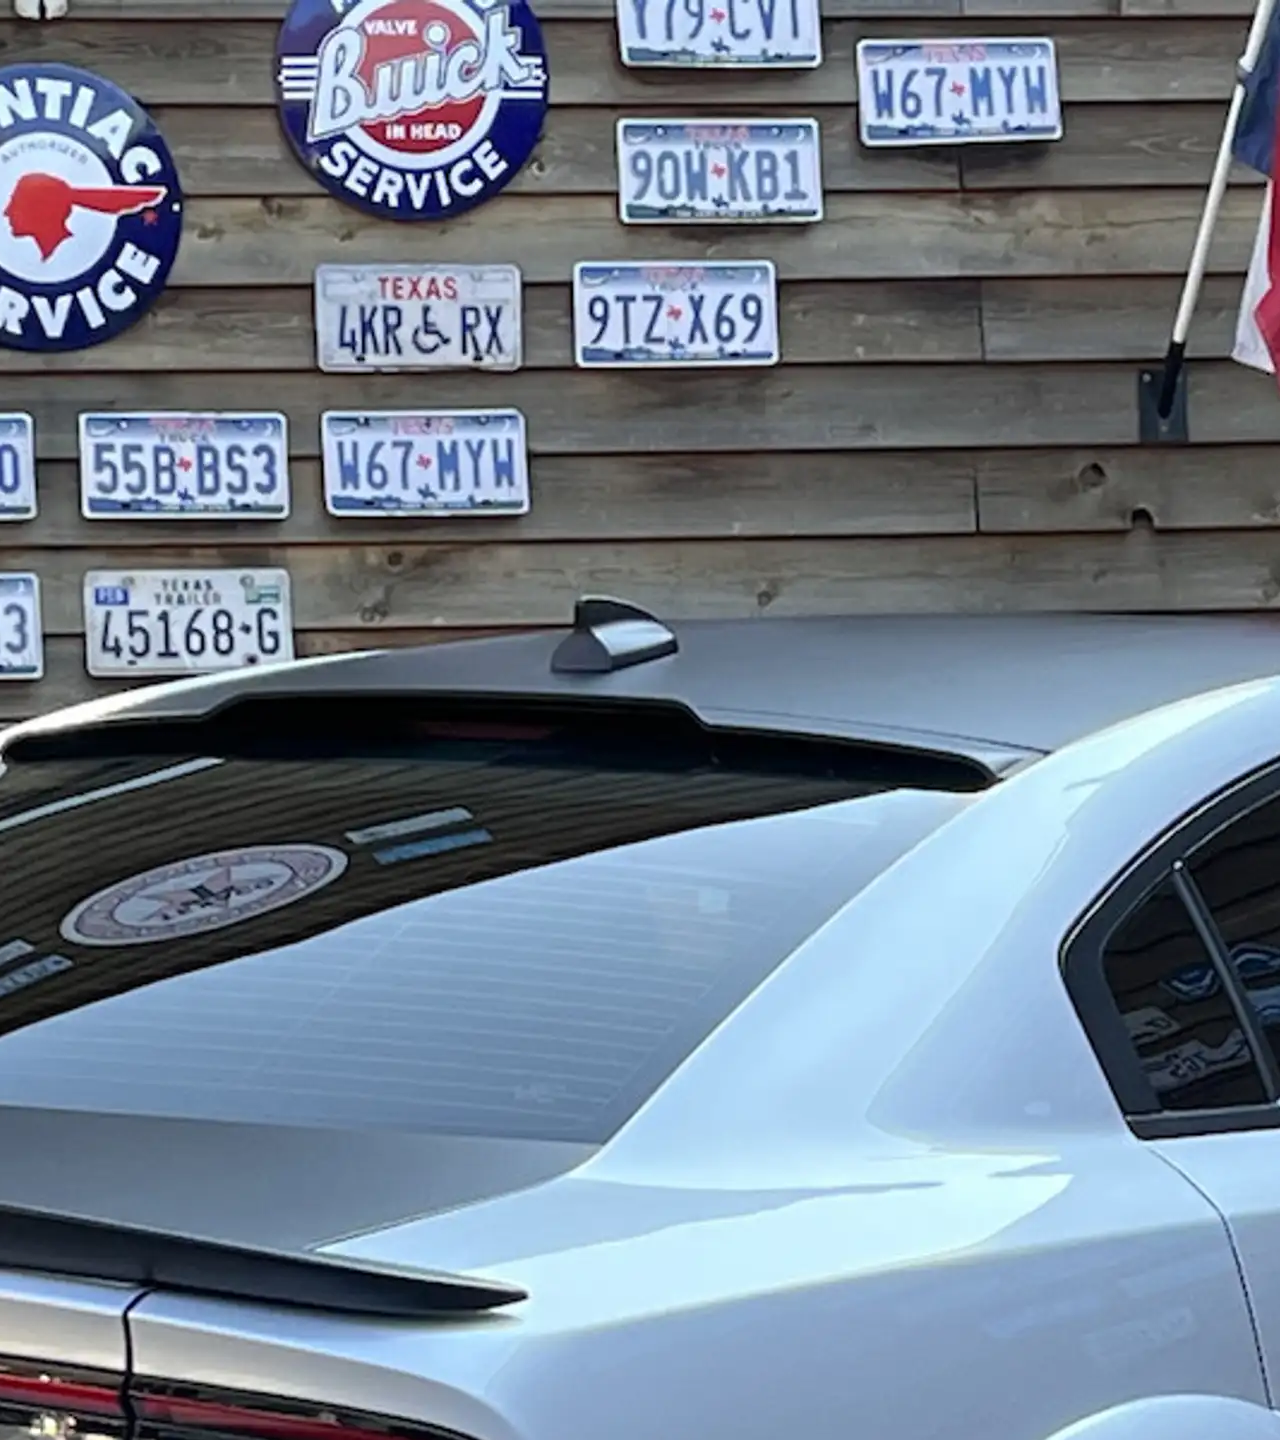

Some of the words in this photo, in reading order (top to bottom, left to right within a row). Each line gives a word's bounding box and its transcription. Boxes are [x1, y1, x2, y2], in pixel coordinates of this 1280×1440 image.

[364, 20, 418, 36] VALVE
[308, 5, 530, 143] Buick
[872, 66, 948, 119] W67
[969, 65, 1047, 116] MYW
[386, 124, 407, 140] IN
[410, 124, 462, 140] HEAD
[320, 140, 509, 210] SERVICE
[378, 275, 458, 301] TEXAS
[339, 304, 403, 356] 4KR
[461, 304, 503, 356] RX
[588, 295, 666, 345] 9TZ
[688, 293, 763, 344] X69
[93, 443, 176, 495] 55B
[197, 443, 278, 496] BS3
[337, 440, 414, 490] W67
[436, 438, 515, 491] MYW
